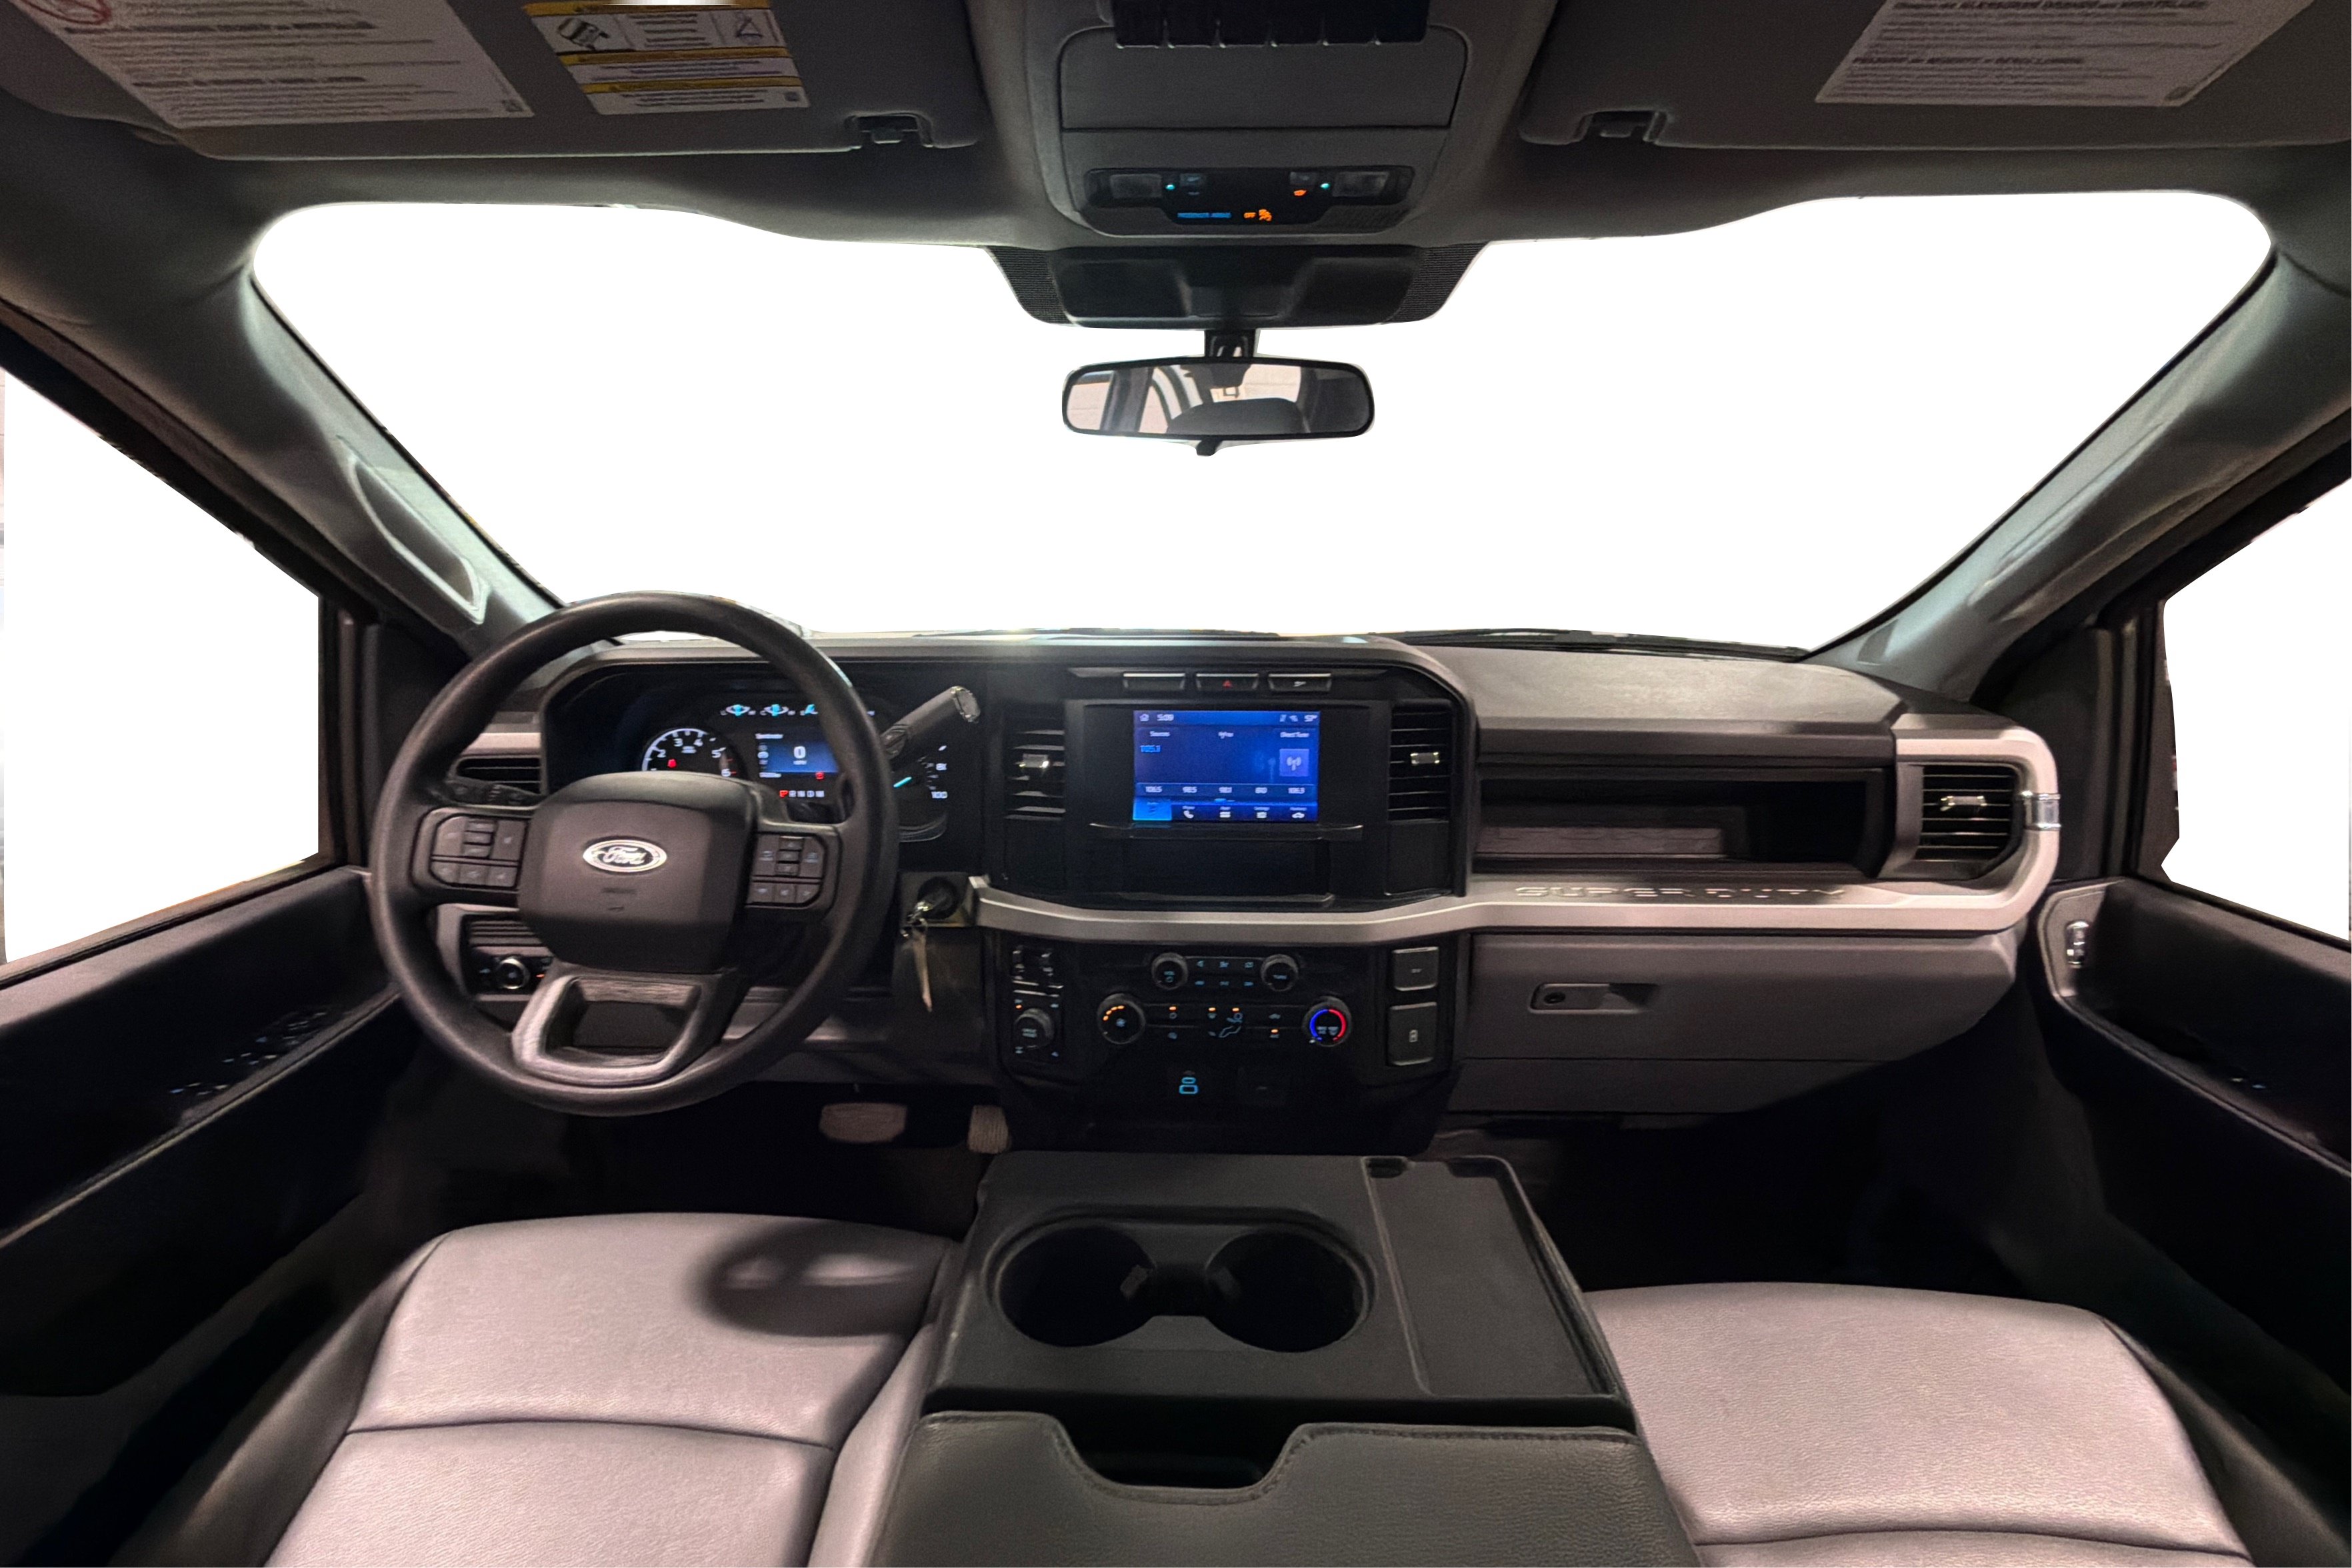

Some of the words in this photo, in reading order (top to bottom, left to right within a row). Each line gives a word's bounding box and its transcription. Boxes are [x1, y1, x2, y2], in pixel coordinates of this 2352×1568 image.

[673, 738, 683, 747] 3
[693, 738, 703, 747] 4
[657, 749, 667, 759] 2
[711, 749, 722, 759] 5
[793, 745, 806, 759] 0
[1515, 887, 1695, 897] SUPER
[1704, 887, 1845, 899] DUTY
